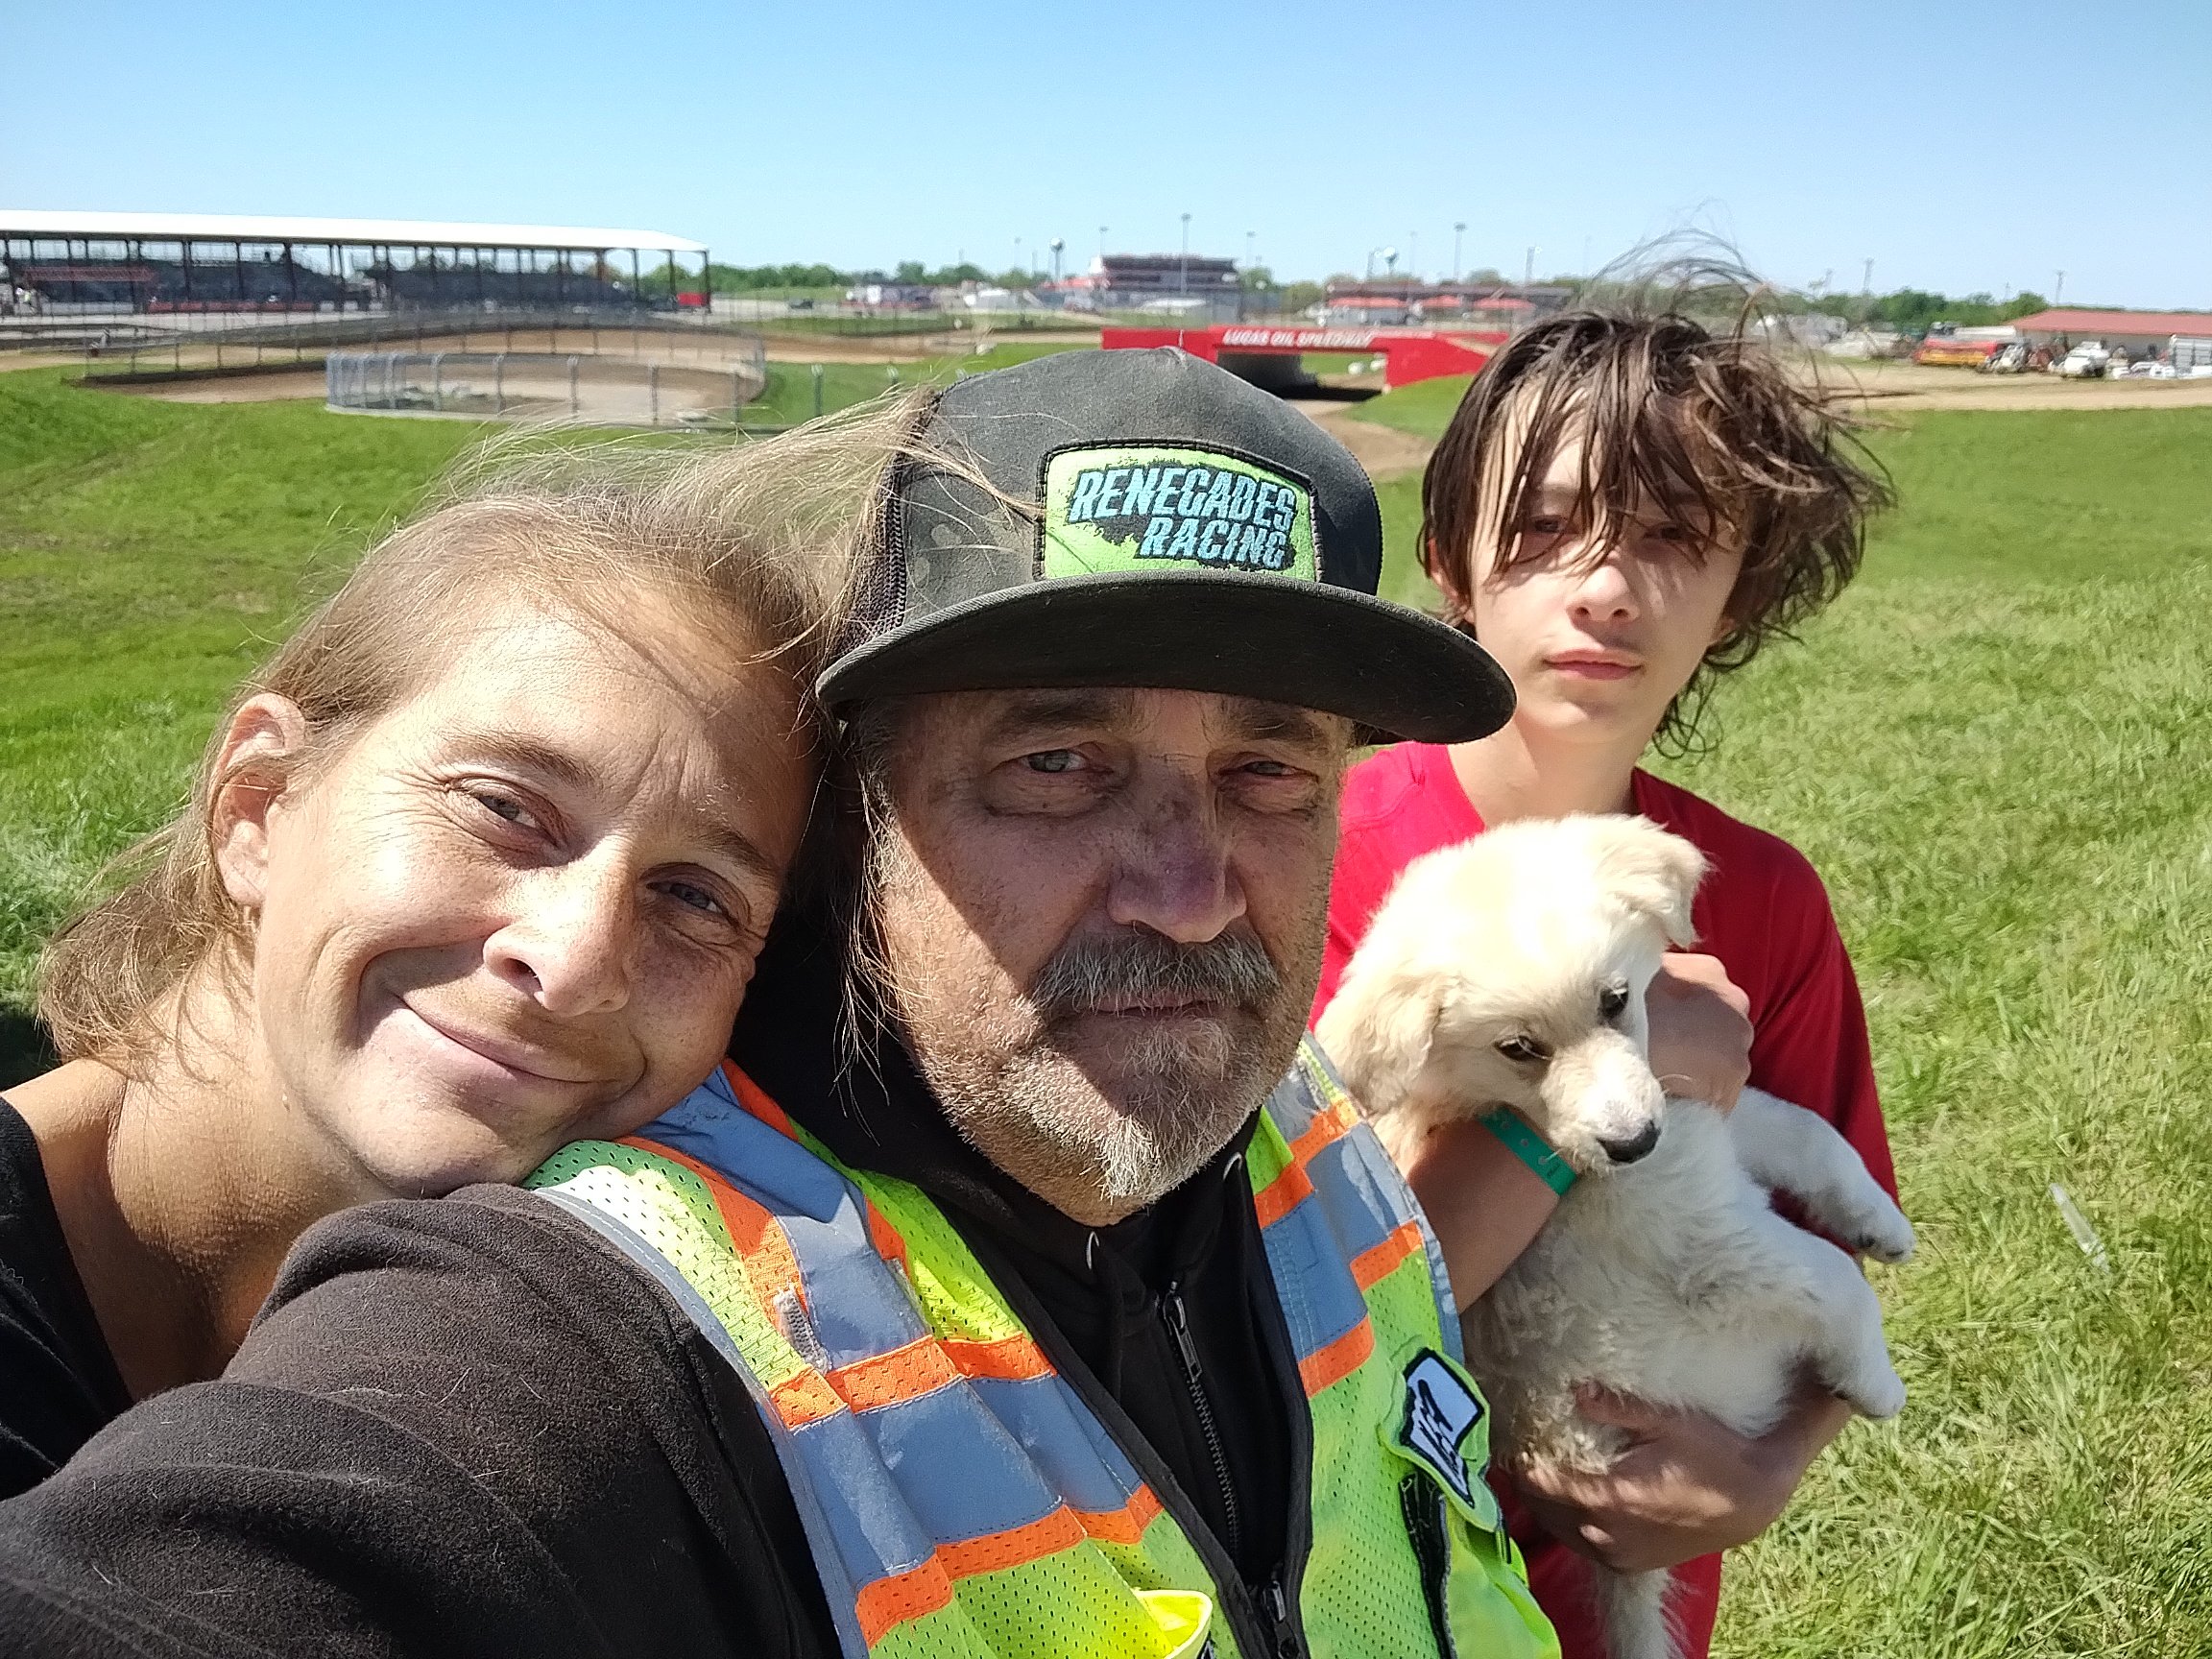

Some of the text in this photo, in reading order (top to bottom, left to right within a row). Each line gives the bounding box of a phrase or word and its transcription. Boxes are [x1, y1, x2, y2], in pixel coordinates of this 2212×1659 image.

[1223, 329, 1270, 346] LUCAS
[1271, 331, 1296, 347] OIL
[1067, 468, 1296, 531] RENEGADES
[1139, 517, 1288, 569] RACING
